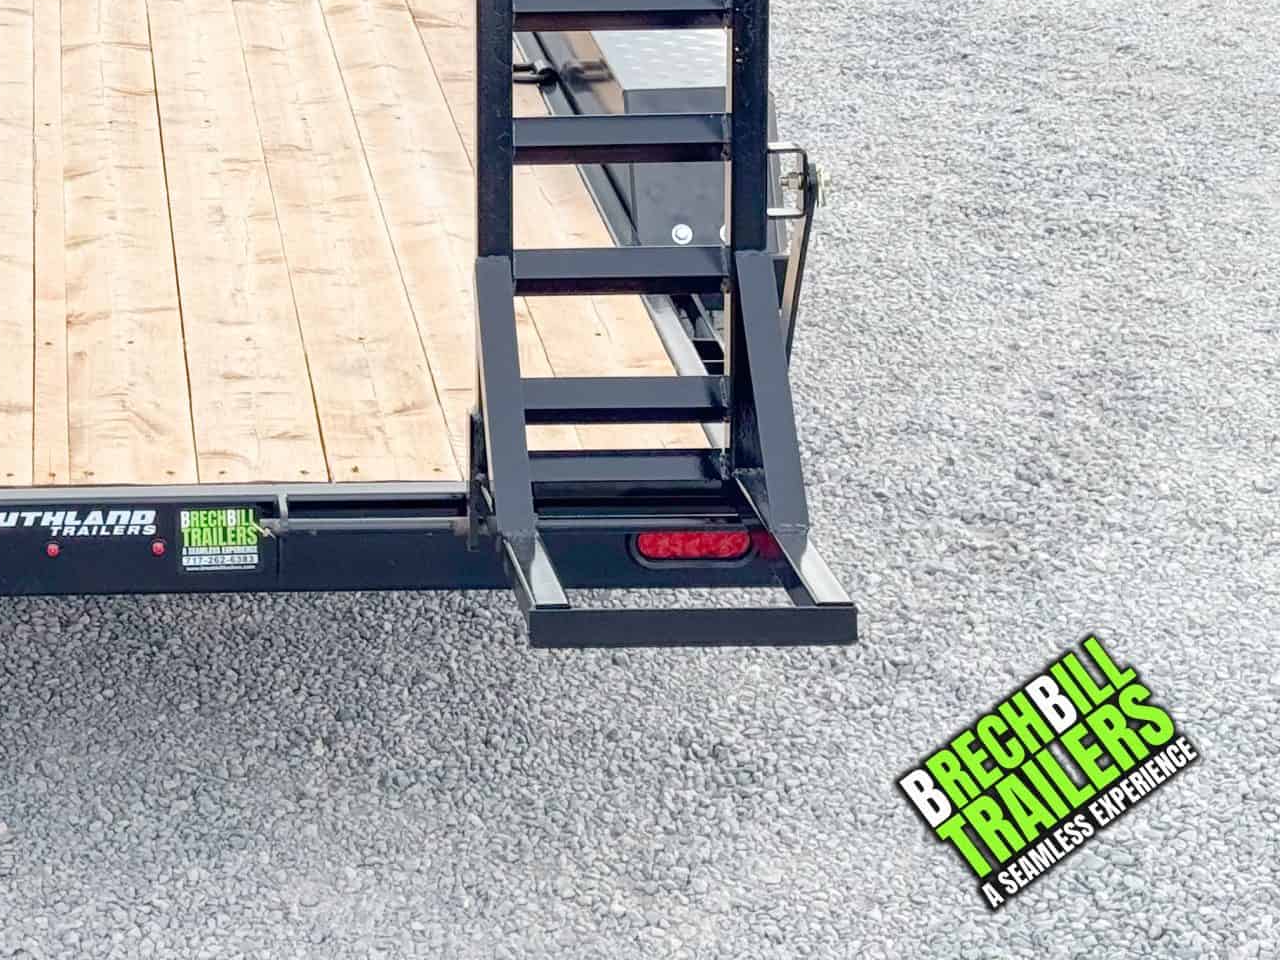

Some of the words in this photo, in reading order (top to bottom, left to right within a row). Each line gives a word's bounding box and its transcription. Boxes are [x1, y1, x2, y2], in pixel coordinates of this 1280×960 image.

[180, 509, 255, 529] BRECHBILL
[51, 525, 156, 537] TRAILERS
[181, 526, 258, 547] TRAILERS
